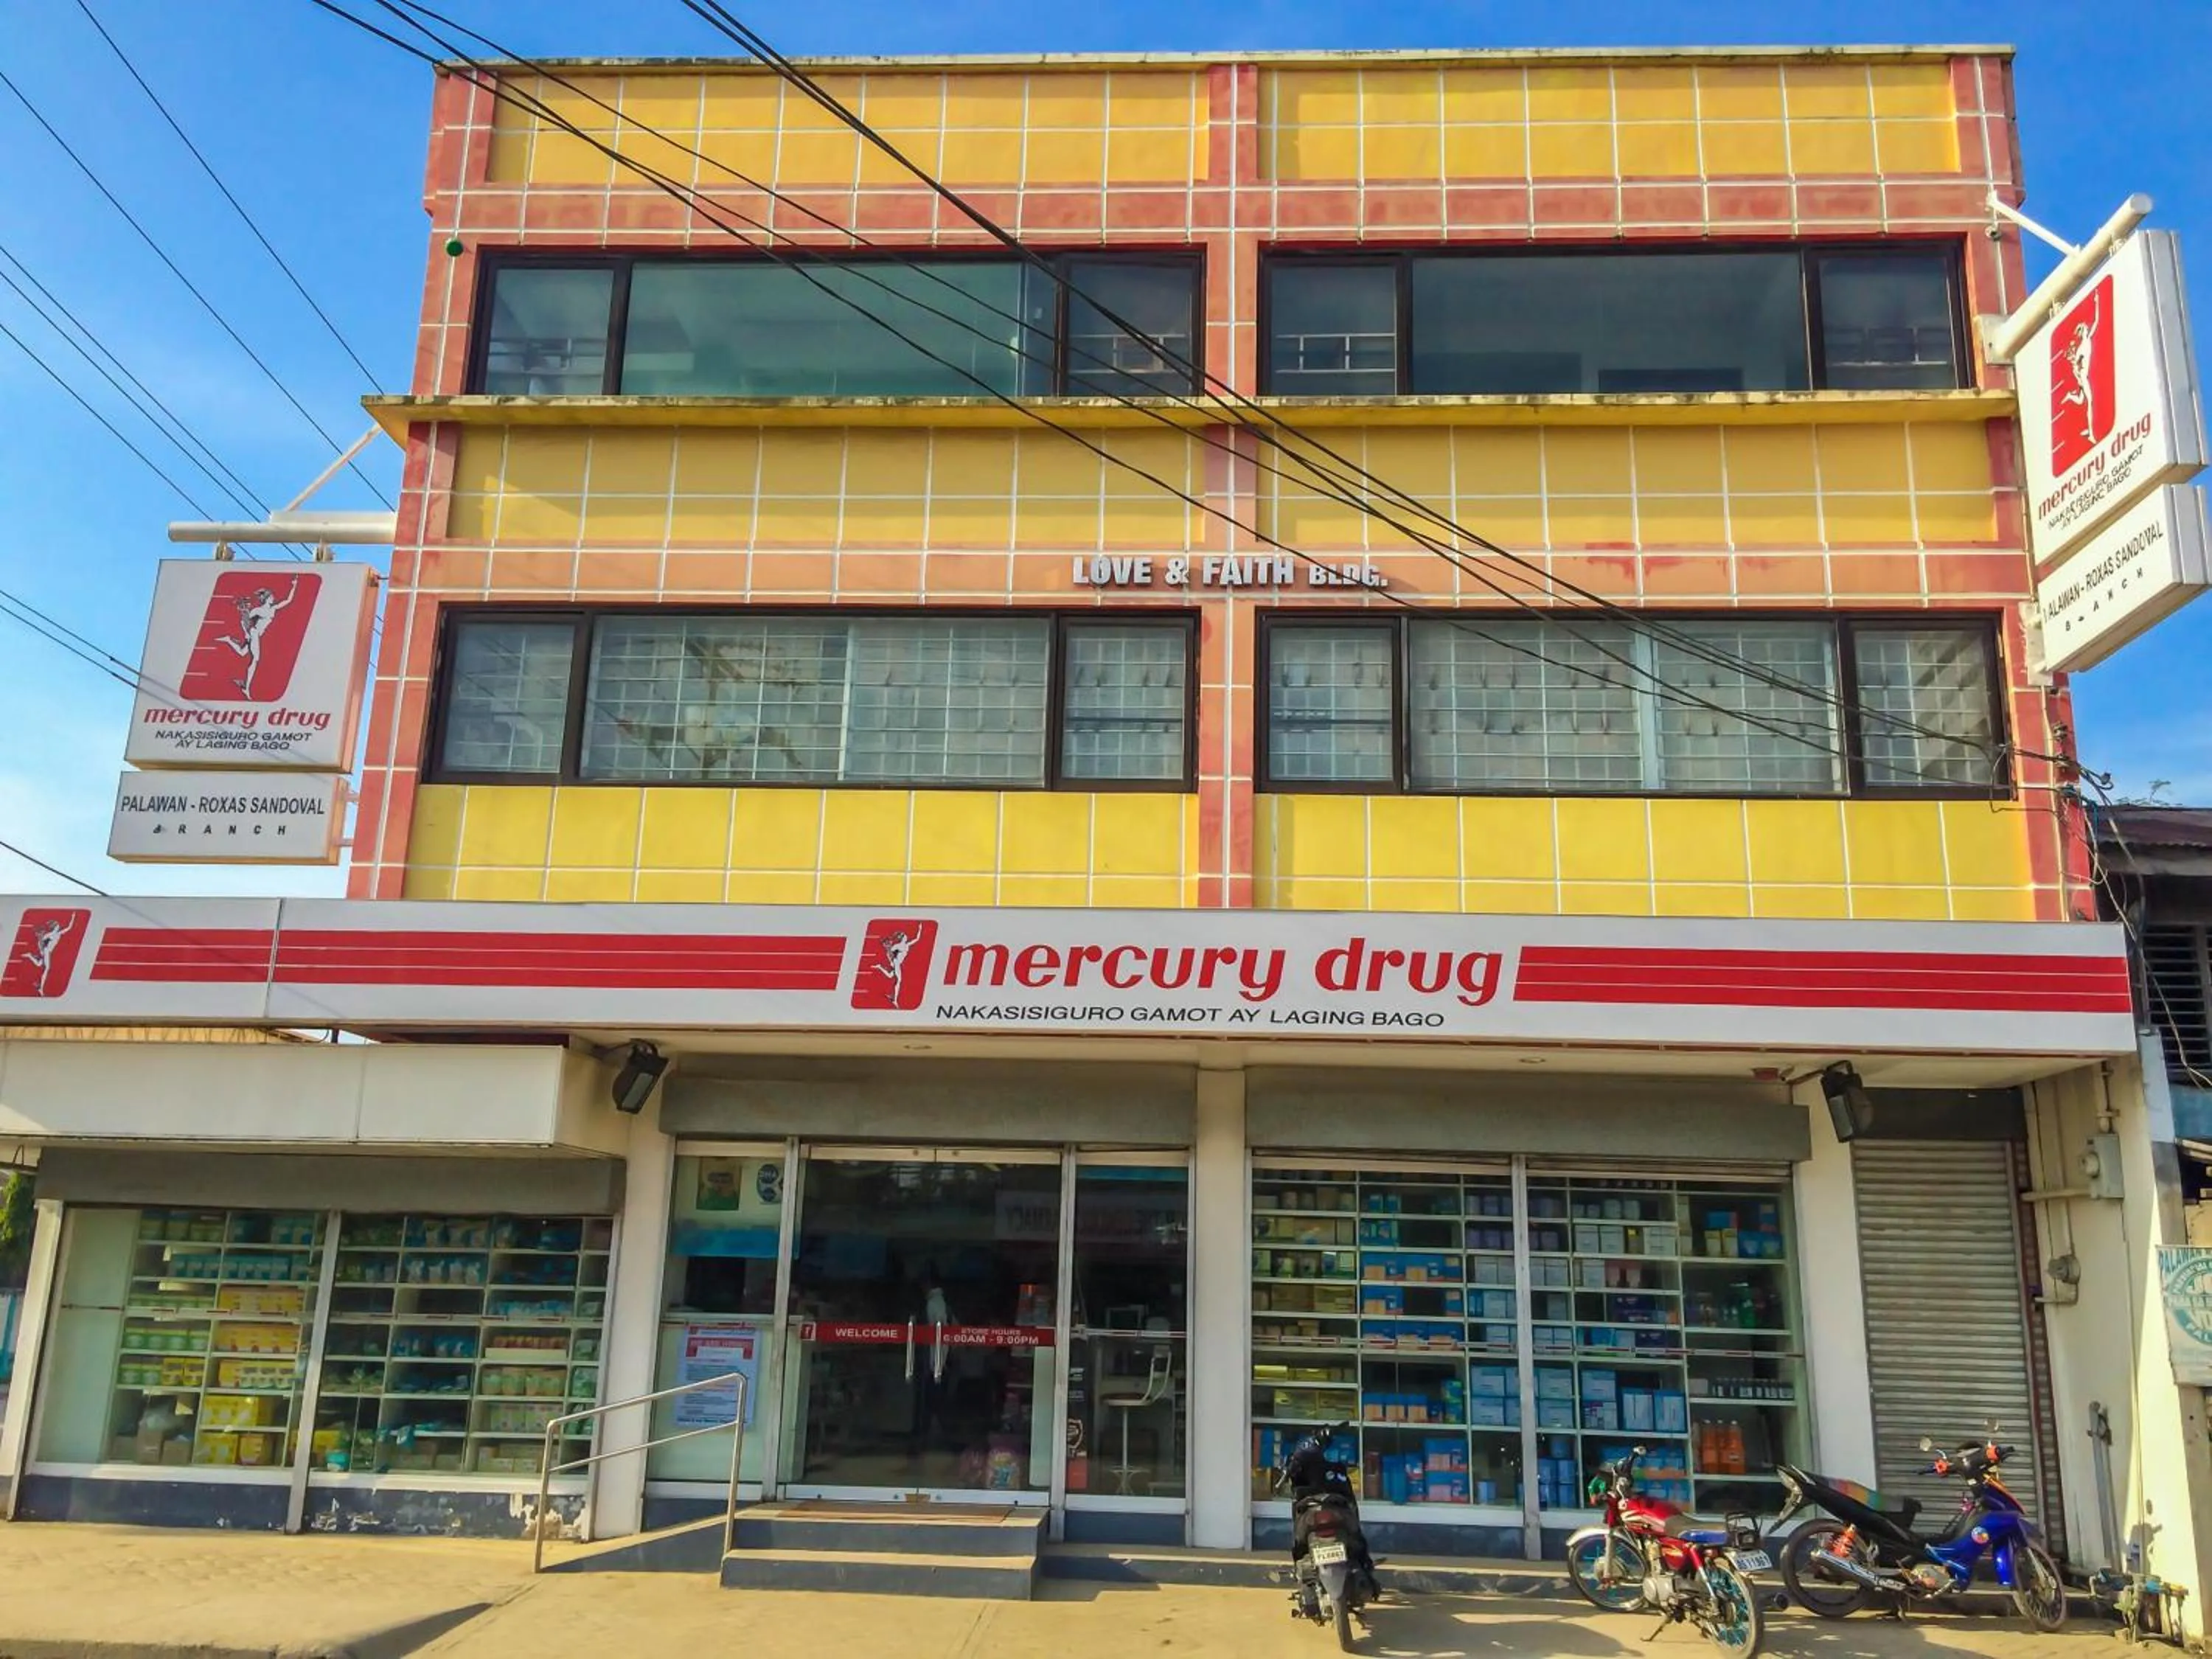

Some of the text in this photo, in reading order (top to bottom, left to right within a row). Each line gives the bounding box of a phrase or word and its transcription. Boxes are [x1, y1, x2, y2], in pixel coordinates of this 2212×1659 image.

[2039, 413, 2151, 520] mercury drug
[2086, 557, 2115, 591] ROXAS
[2115, 520, 2163, 569] SANDOVAL
[1072, 555, 1388, 587] LOVE & FAITH BLDG.
[144, 707, 331, 731] mercury drug
[156, 730, 313, 742] NAKASISIGURO GAMOT
[175, 740, 290, 751] AY LAGING BAGO
[121, 796, 187, 813] PALAWAN
[198, 796, 246, 813] ROXAS
[250, 797, 325, 815] SANDOVAL
[943, 937, 1503, 1006] mercury drug
[936, 1005, 1445, 1027] NAKASISIGURO GAMOT AY LAGING BAGO
[835, 1327, 898, 1339] WELCOME
